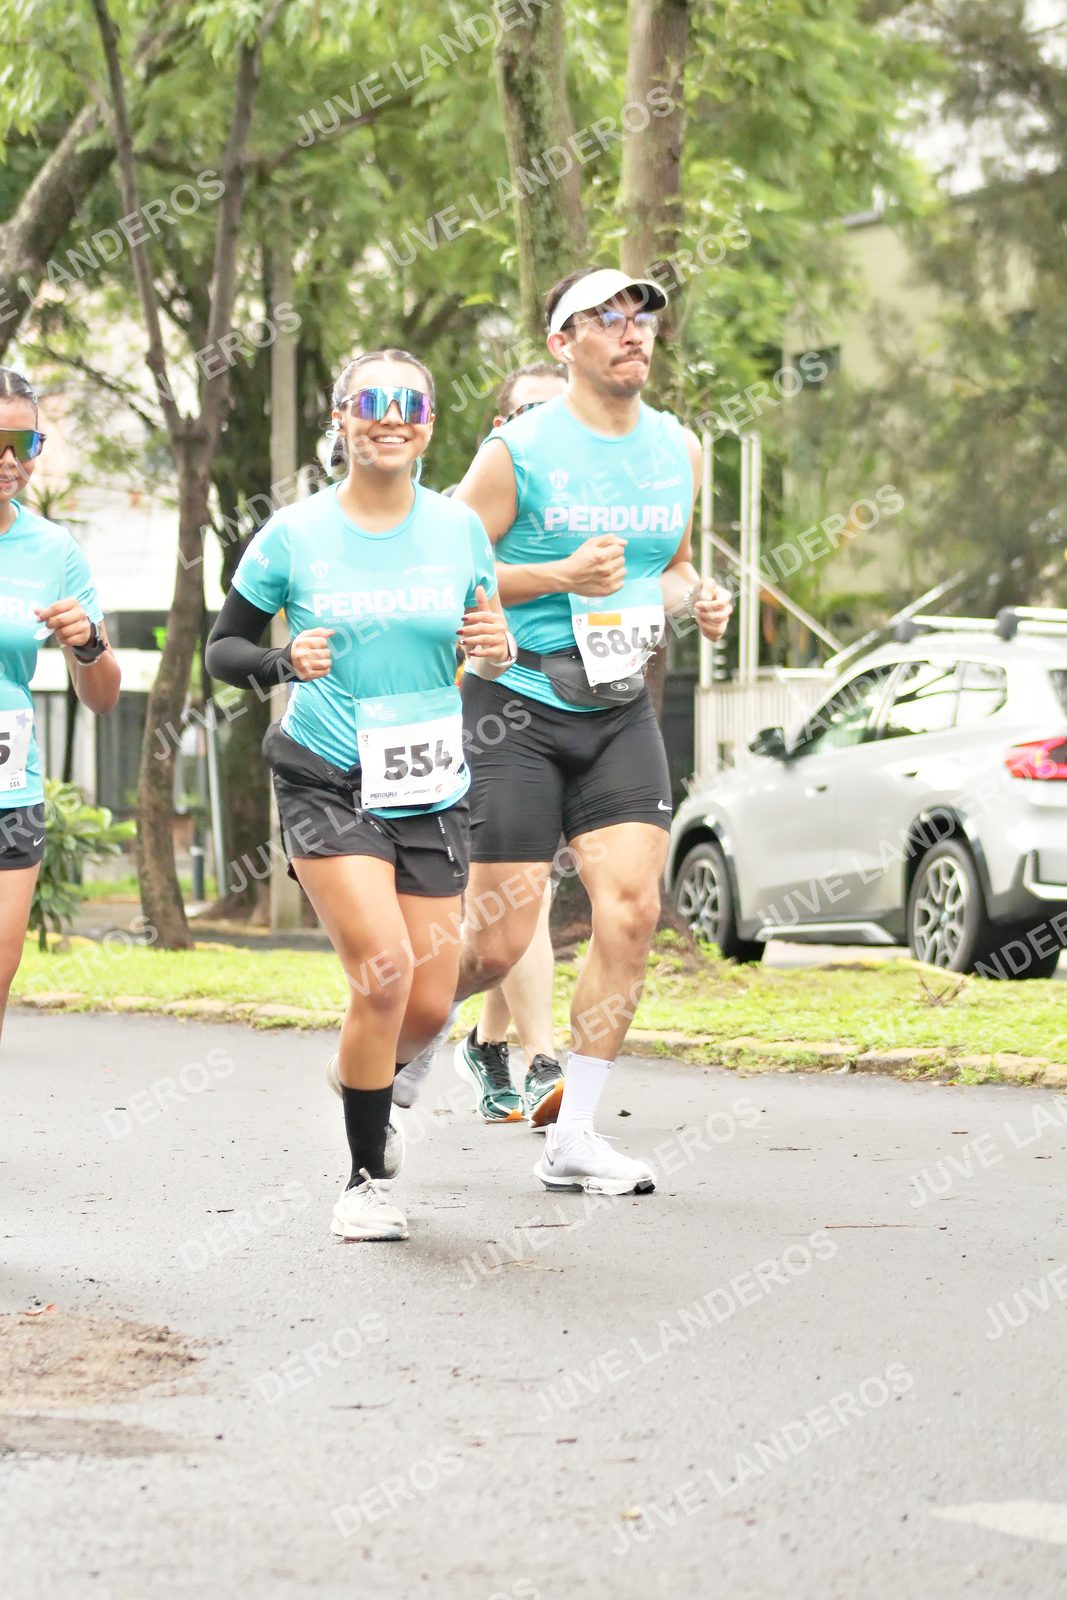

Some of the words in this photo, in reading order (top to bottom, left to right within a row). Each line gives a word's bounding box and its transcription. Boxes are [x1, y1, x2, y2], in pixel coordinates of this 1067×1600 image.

[544, 503, 684, 532] PERDURA
[312, 586, 457, 617] PERDURA
[384, 740, 452, 780] 554
